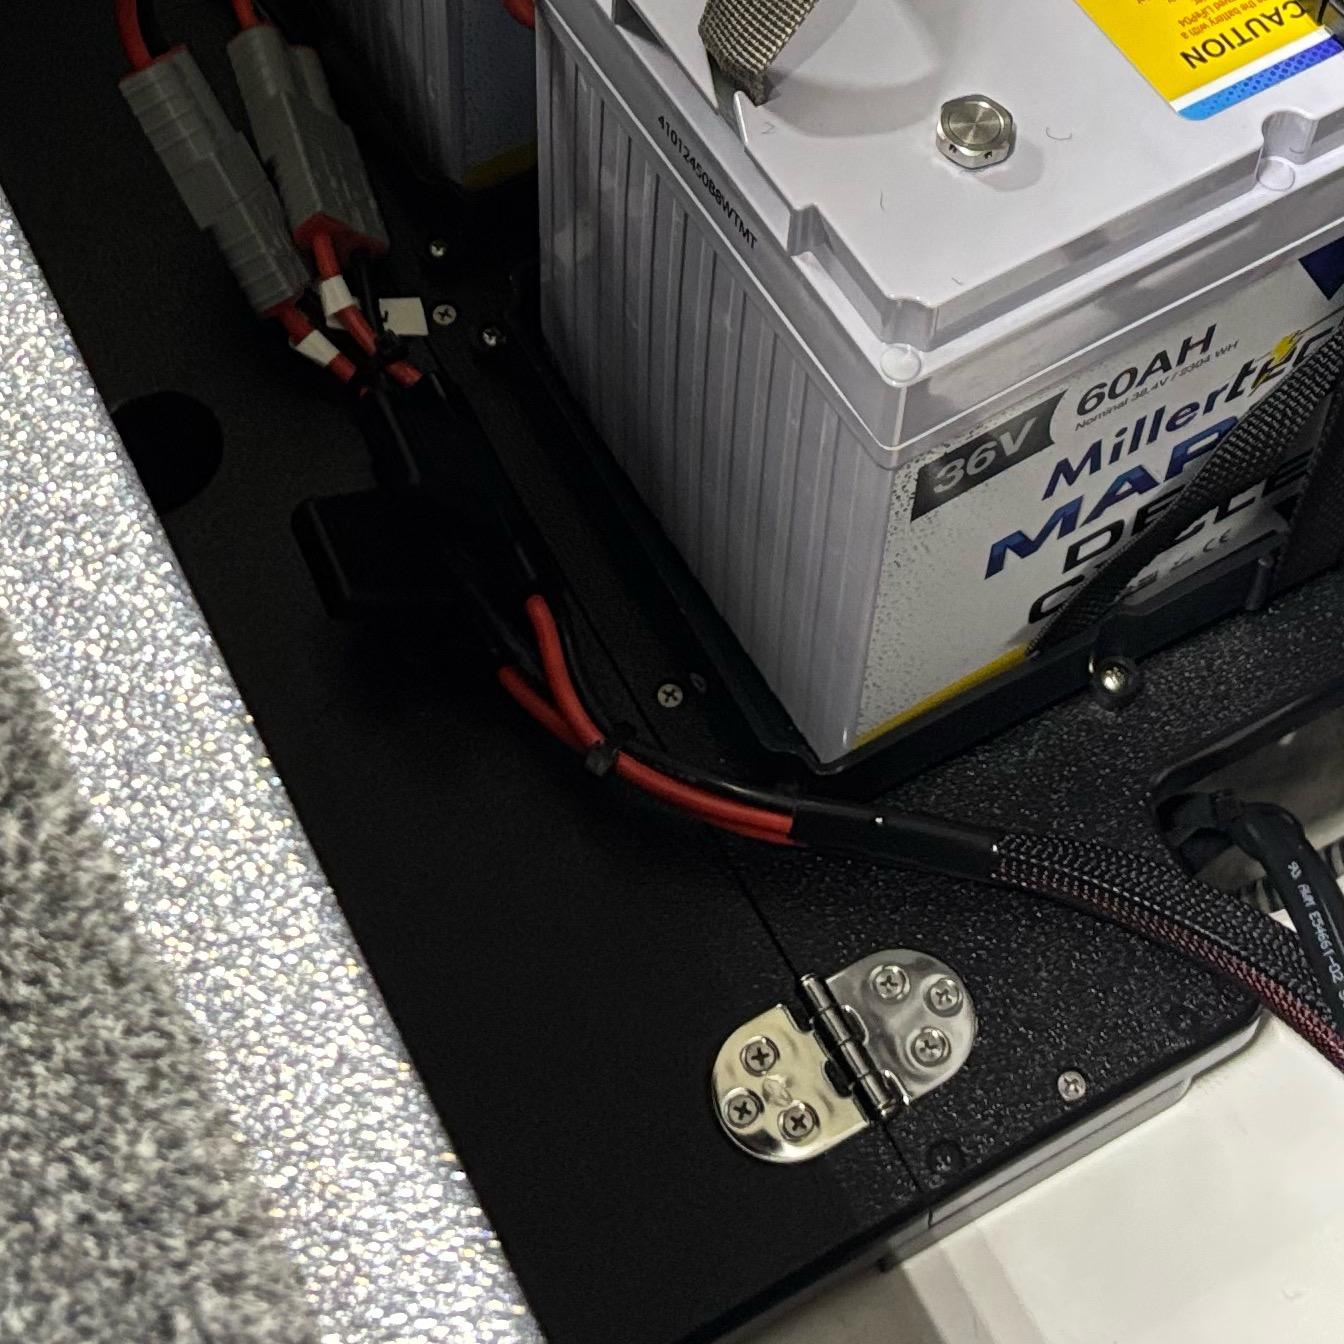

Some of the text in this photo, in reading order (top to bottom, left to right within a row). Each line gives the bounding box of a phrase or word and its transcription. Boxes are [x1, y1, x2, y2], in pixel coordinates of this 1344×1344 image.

[932, 322, 1217, 496] 36V 60AH
[1041, 322, 1335, 501] Millertec
